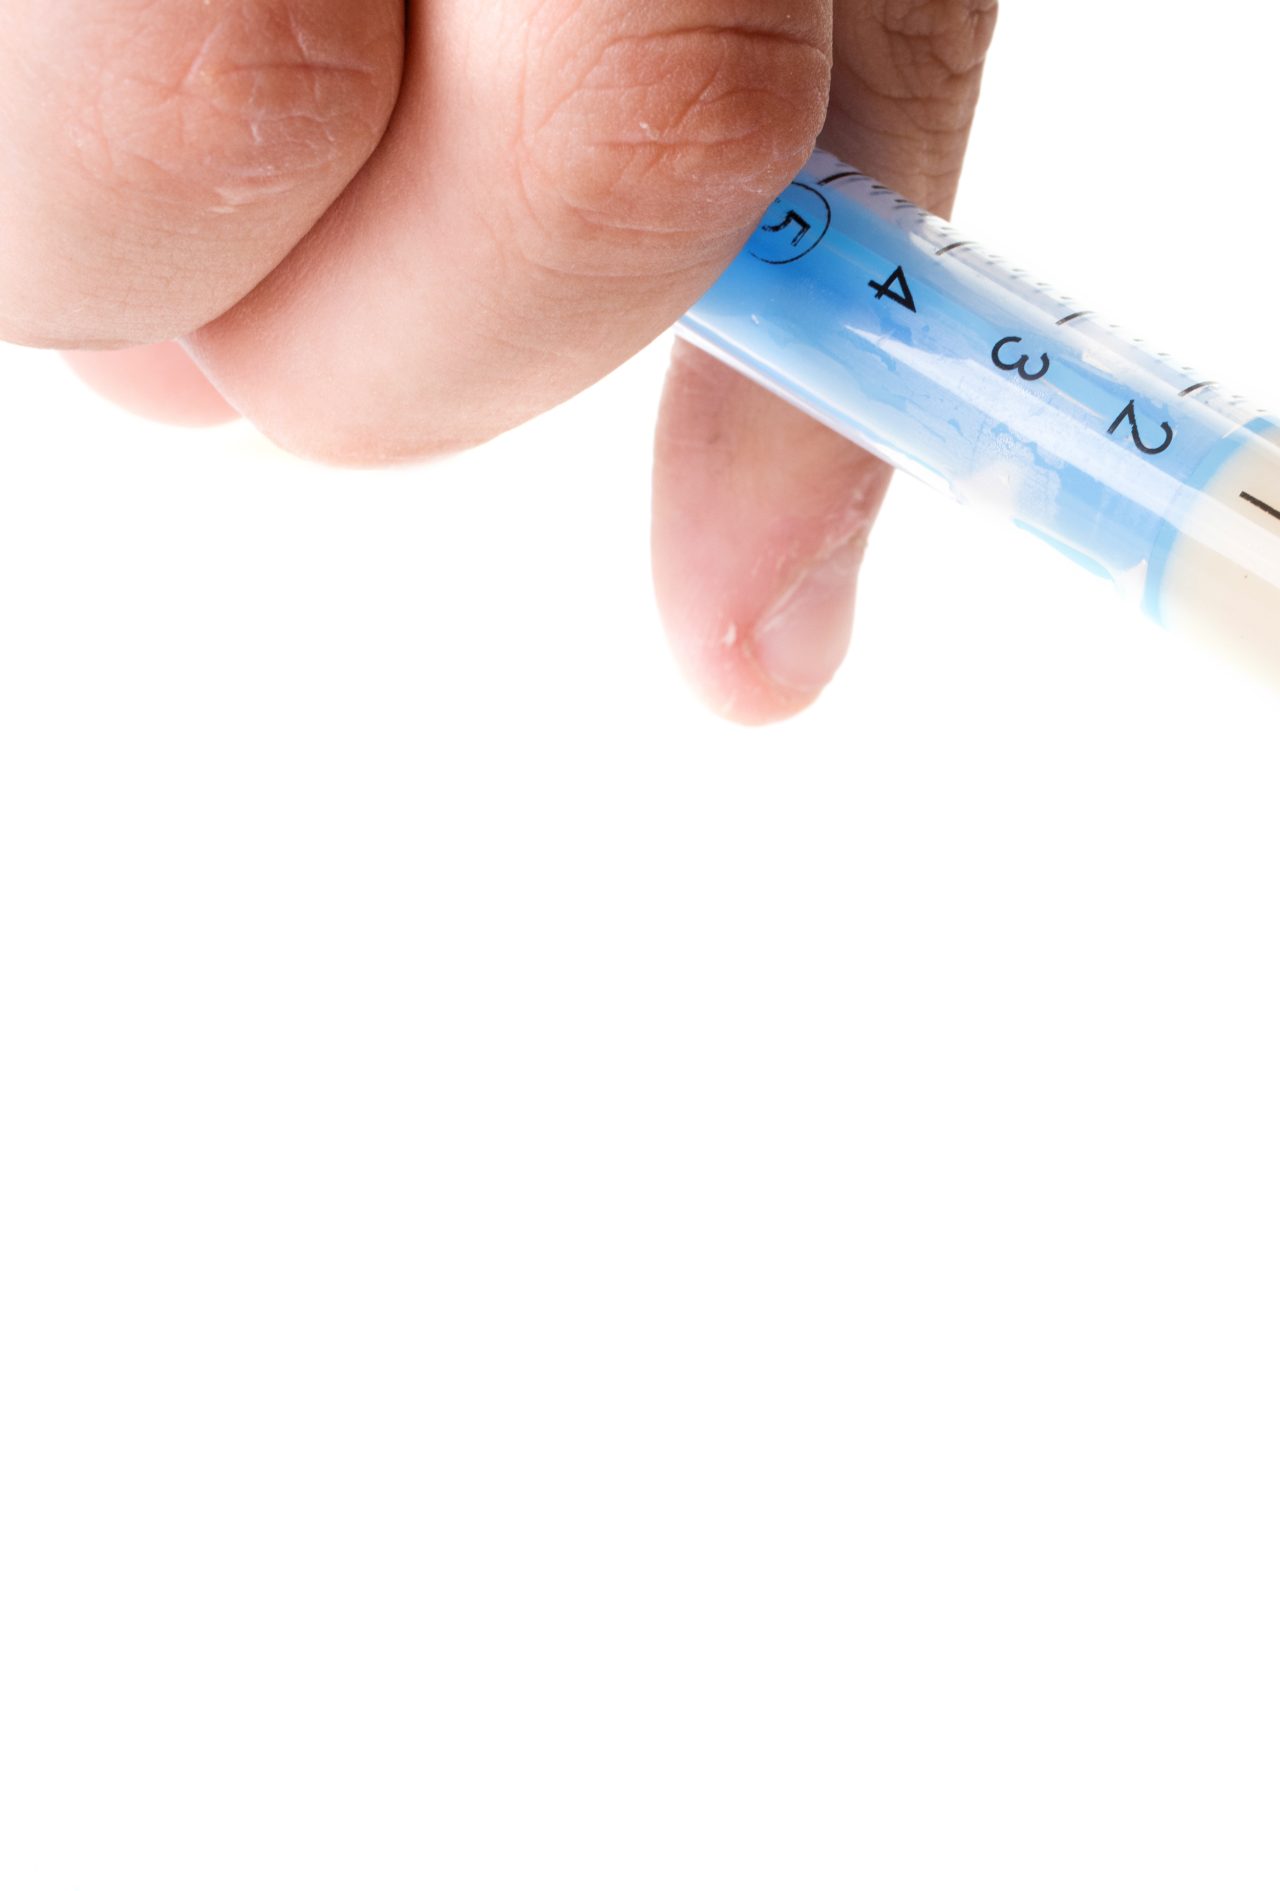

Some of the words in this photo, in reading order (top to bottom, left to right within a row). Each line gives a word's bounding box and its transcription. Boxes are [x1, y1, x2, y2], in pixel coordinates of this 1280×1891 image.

[761, 198, 811, 248] 5
[867, 265, 917, 313] 4
[991, 336, 1050, 381] 3
[1108, 399, 1173, 455] 2
